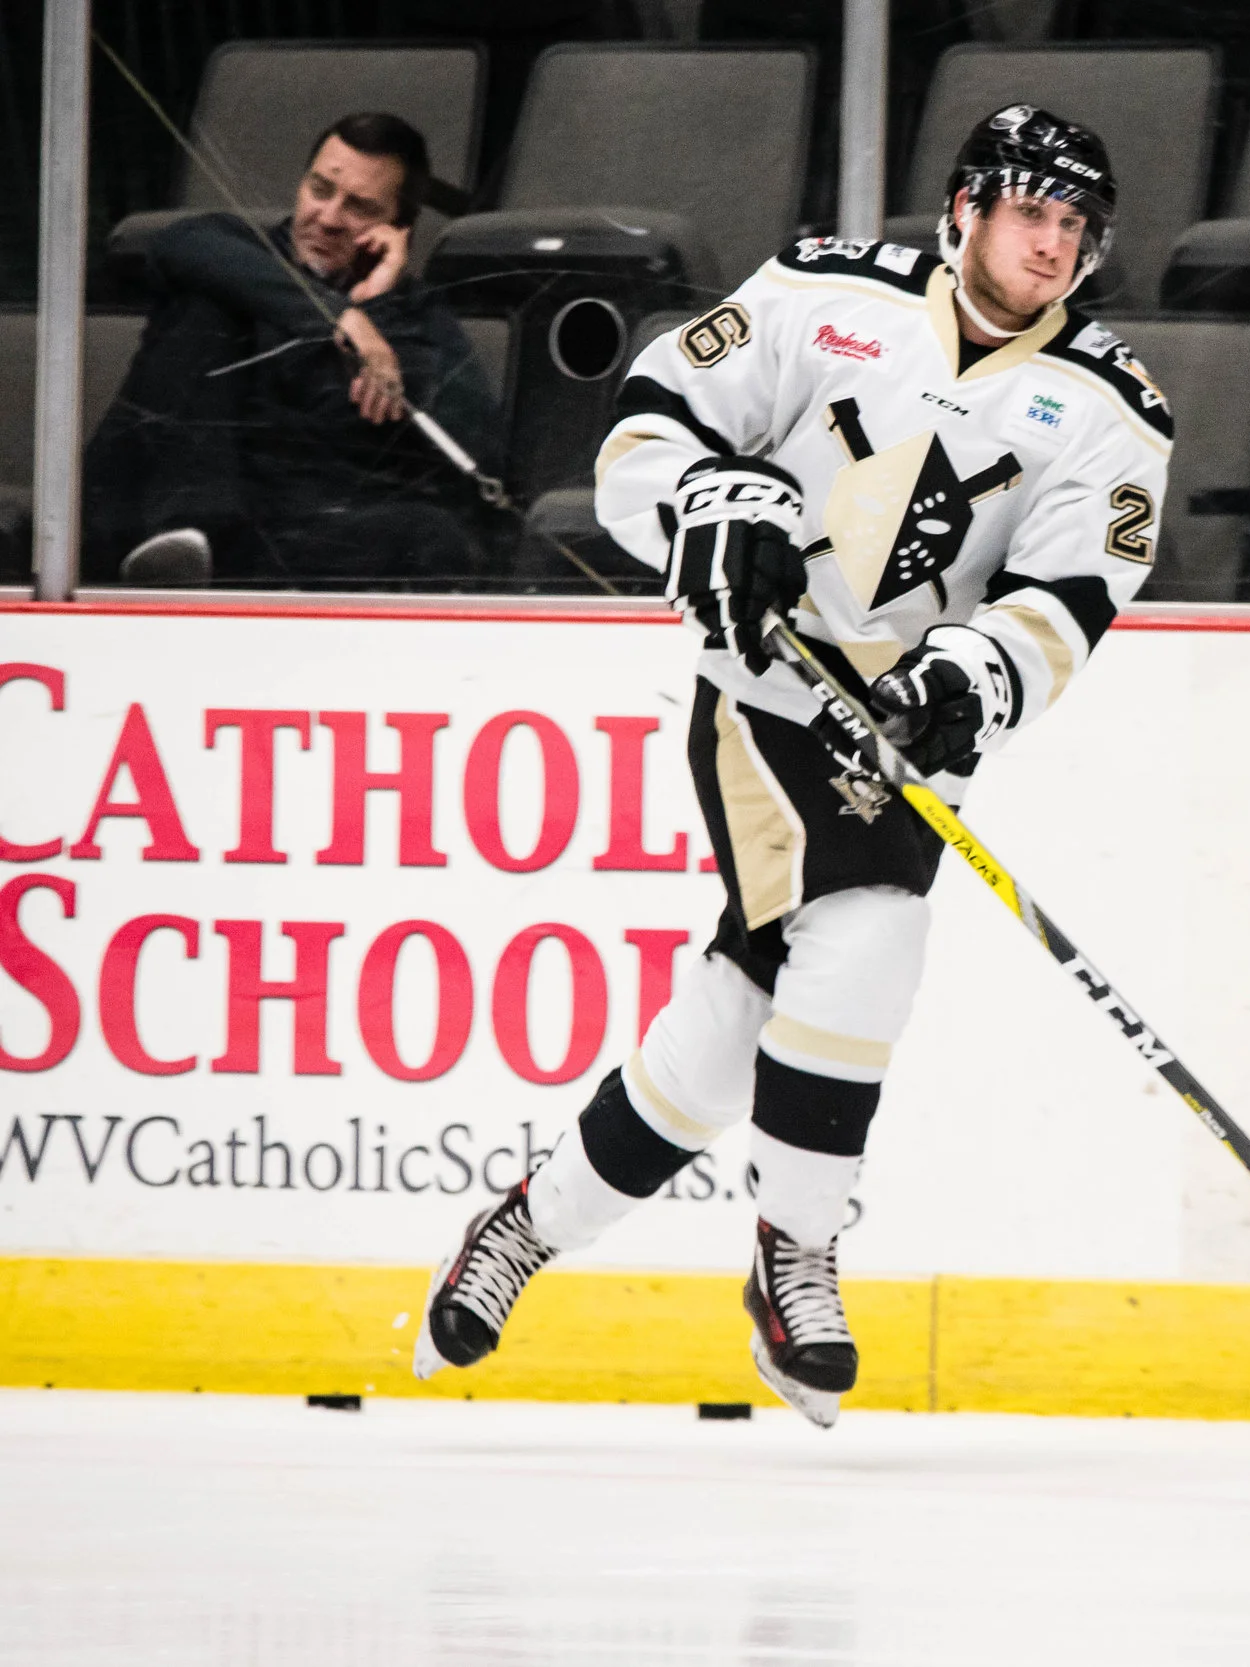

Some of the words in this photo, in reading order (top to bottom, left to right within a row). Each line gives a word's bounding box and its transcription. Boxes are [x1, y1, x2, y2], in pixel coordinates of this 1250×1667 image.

[1053, 155, 1103, 180] CCM
[678, 301, 752, 369] 6
[920, 392, 970, 417] CCM
[682, 482, 804, 516] CCM
[1104, 483, 1156, 566] 2
[811, 680, 871, 741] CCM
[0, 662, 718, 874] CATHOL
[1062, 955, 1175, 1070] CCM
